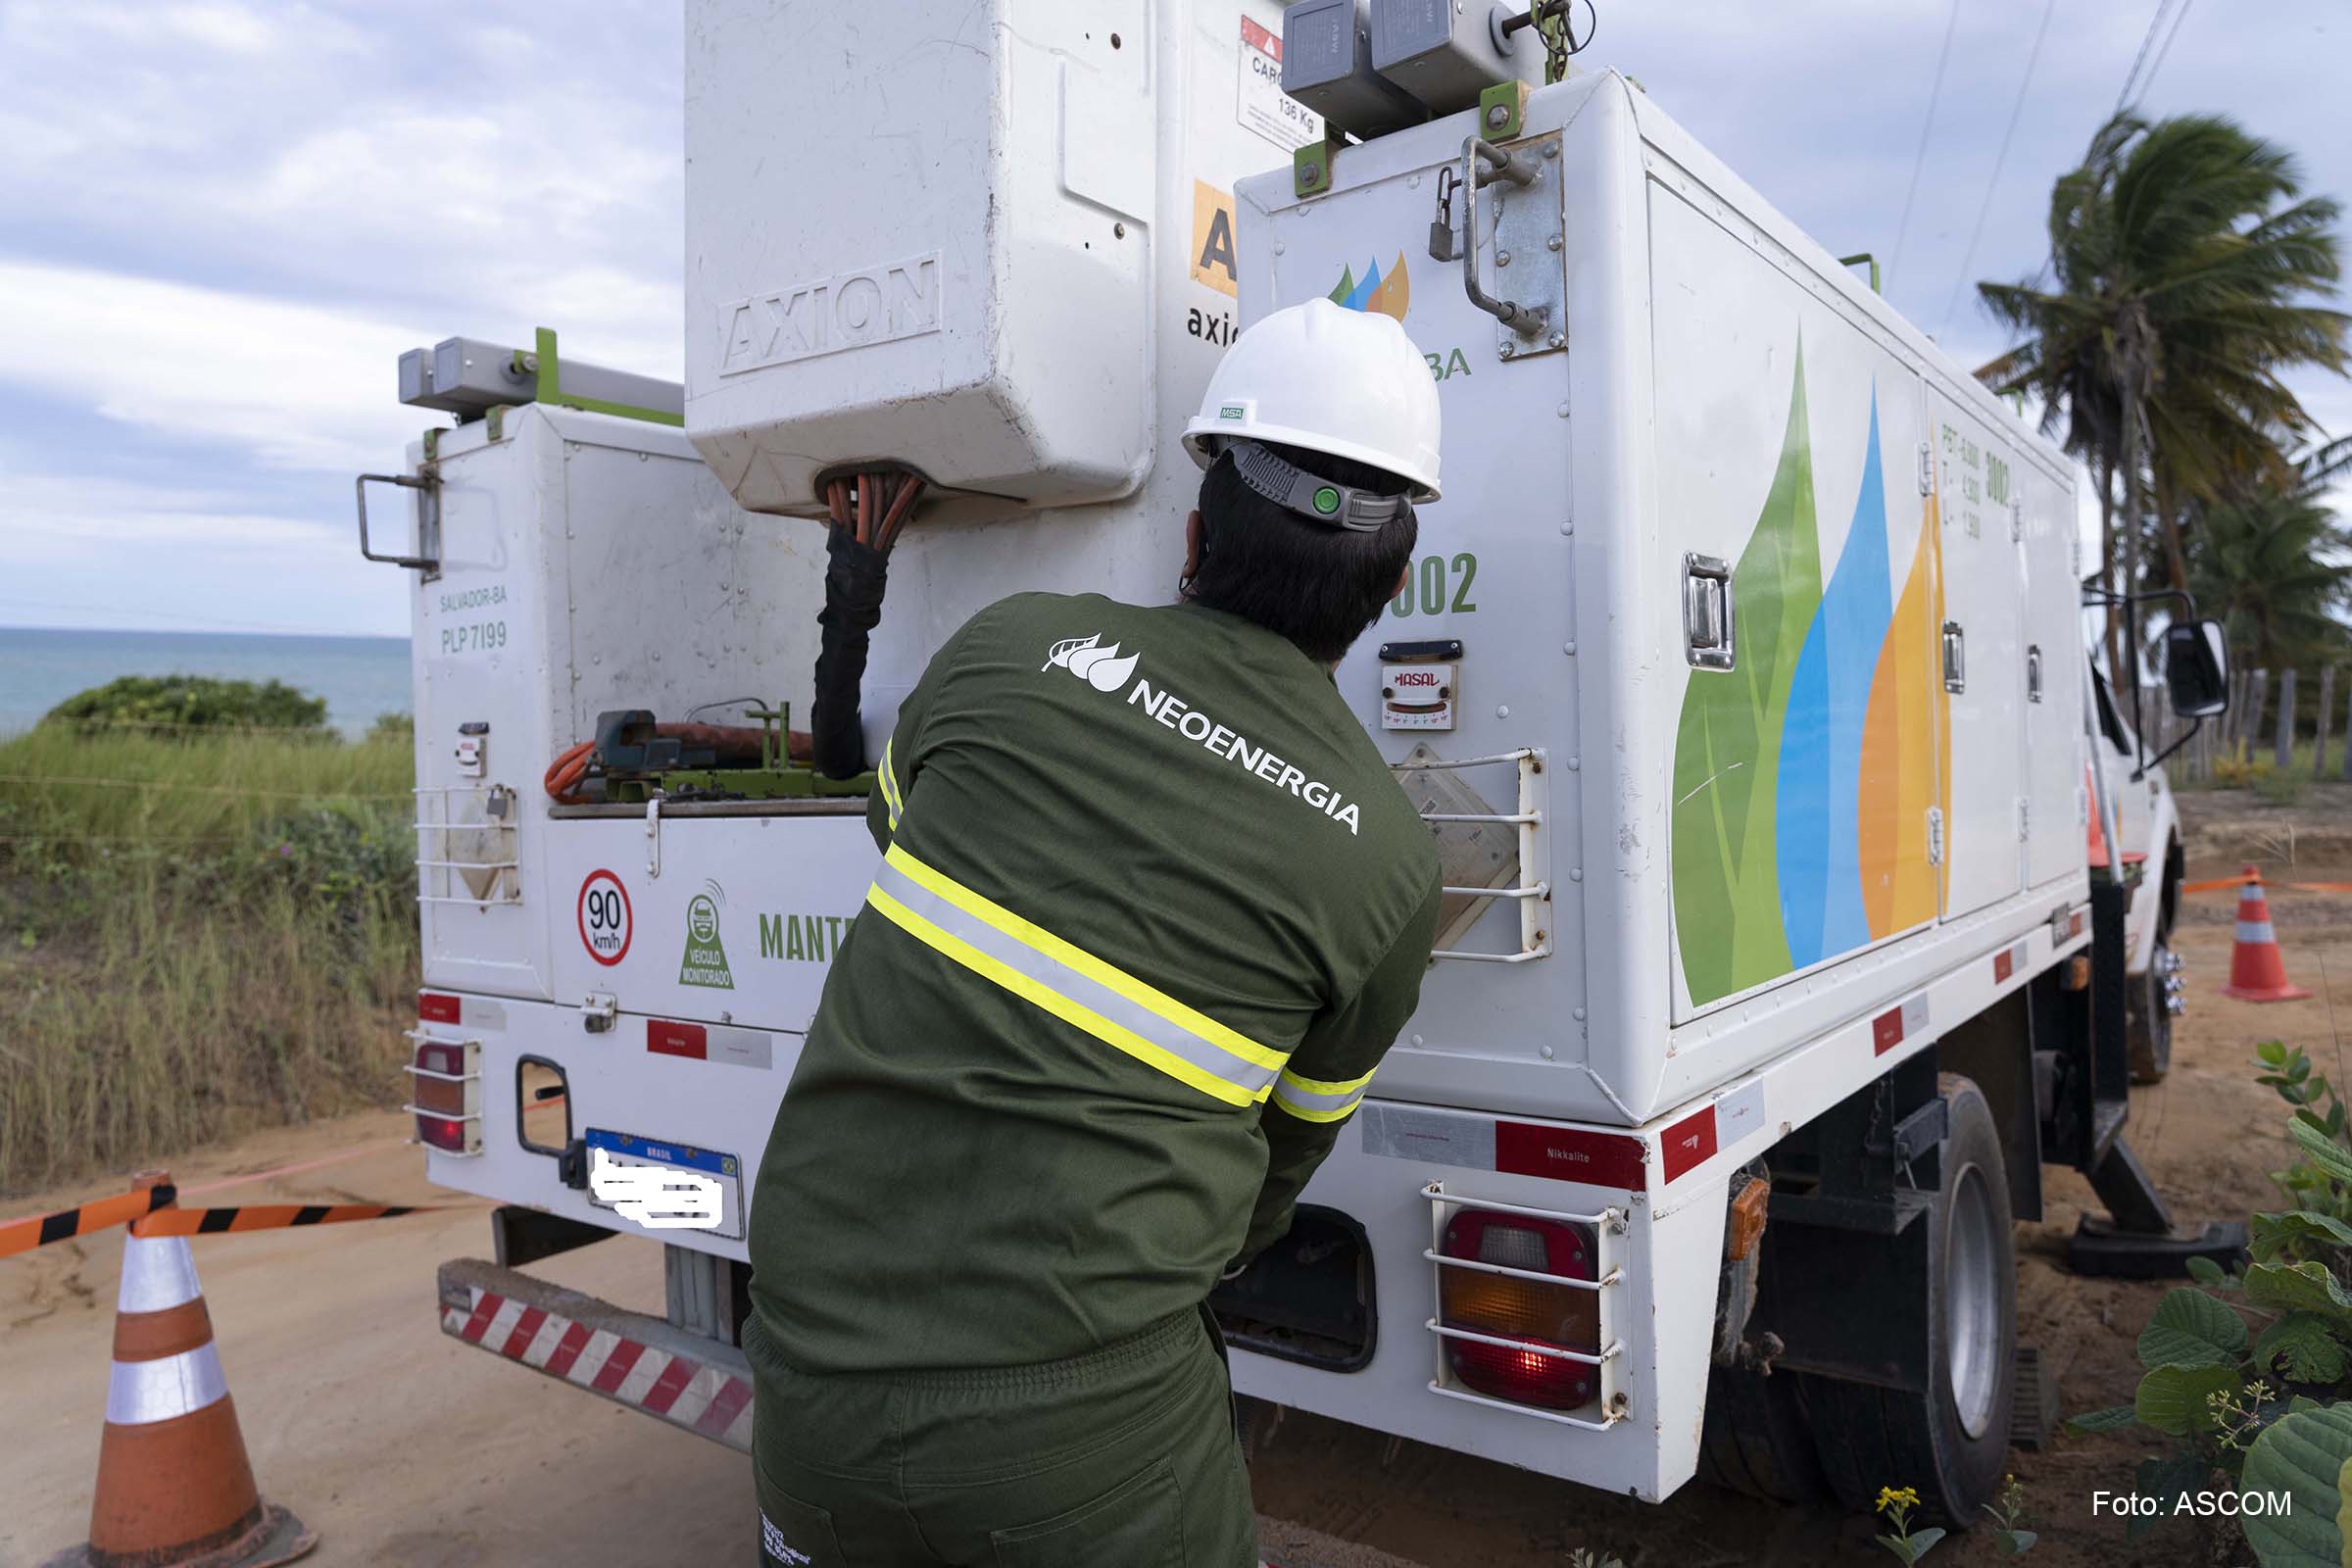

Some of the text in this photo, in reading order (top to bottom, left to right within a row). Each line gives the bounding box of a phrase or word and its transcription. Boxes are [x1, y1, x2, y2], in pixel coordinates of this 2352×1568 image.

[1278, 97, 1297, 122] 136
[1299, 109, 1314, 133] Kg
[722, 259, 935, 369] AXION
[1221, 408, 1244, 418] MSA
[440, 585, 508, 612] SALVADOR-BA
[442, 621, 507, 655] PLP 7199
[1127, 678, 1360, 836] NEOENERGIA
[588, 890, 620, 929] 90
[593, 932, 620, 951] km/h
[760, 912, 856, 962] MANT
[689, 946, 721, 965] VEÍCULO
[683, 967, 730, 986] MONITORADO
[1546, 1147, 1590, 1163] Nikkalite
